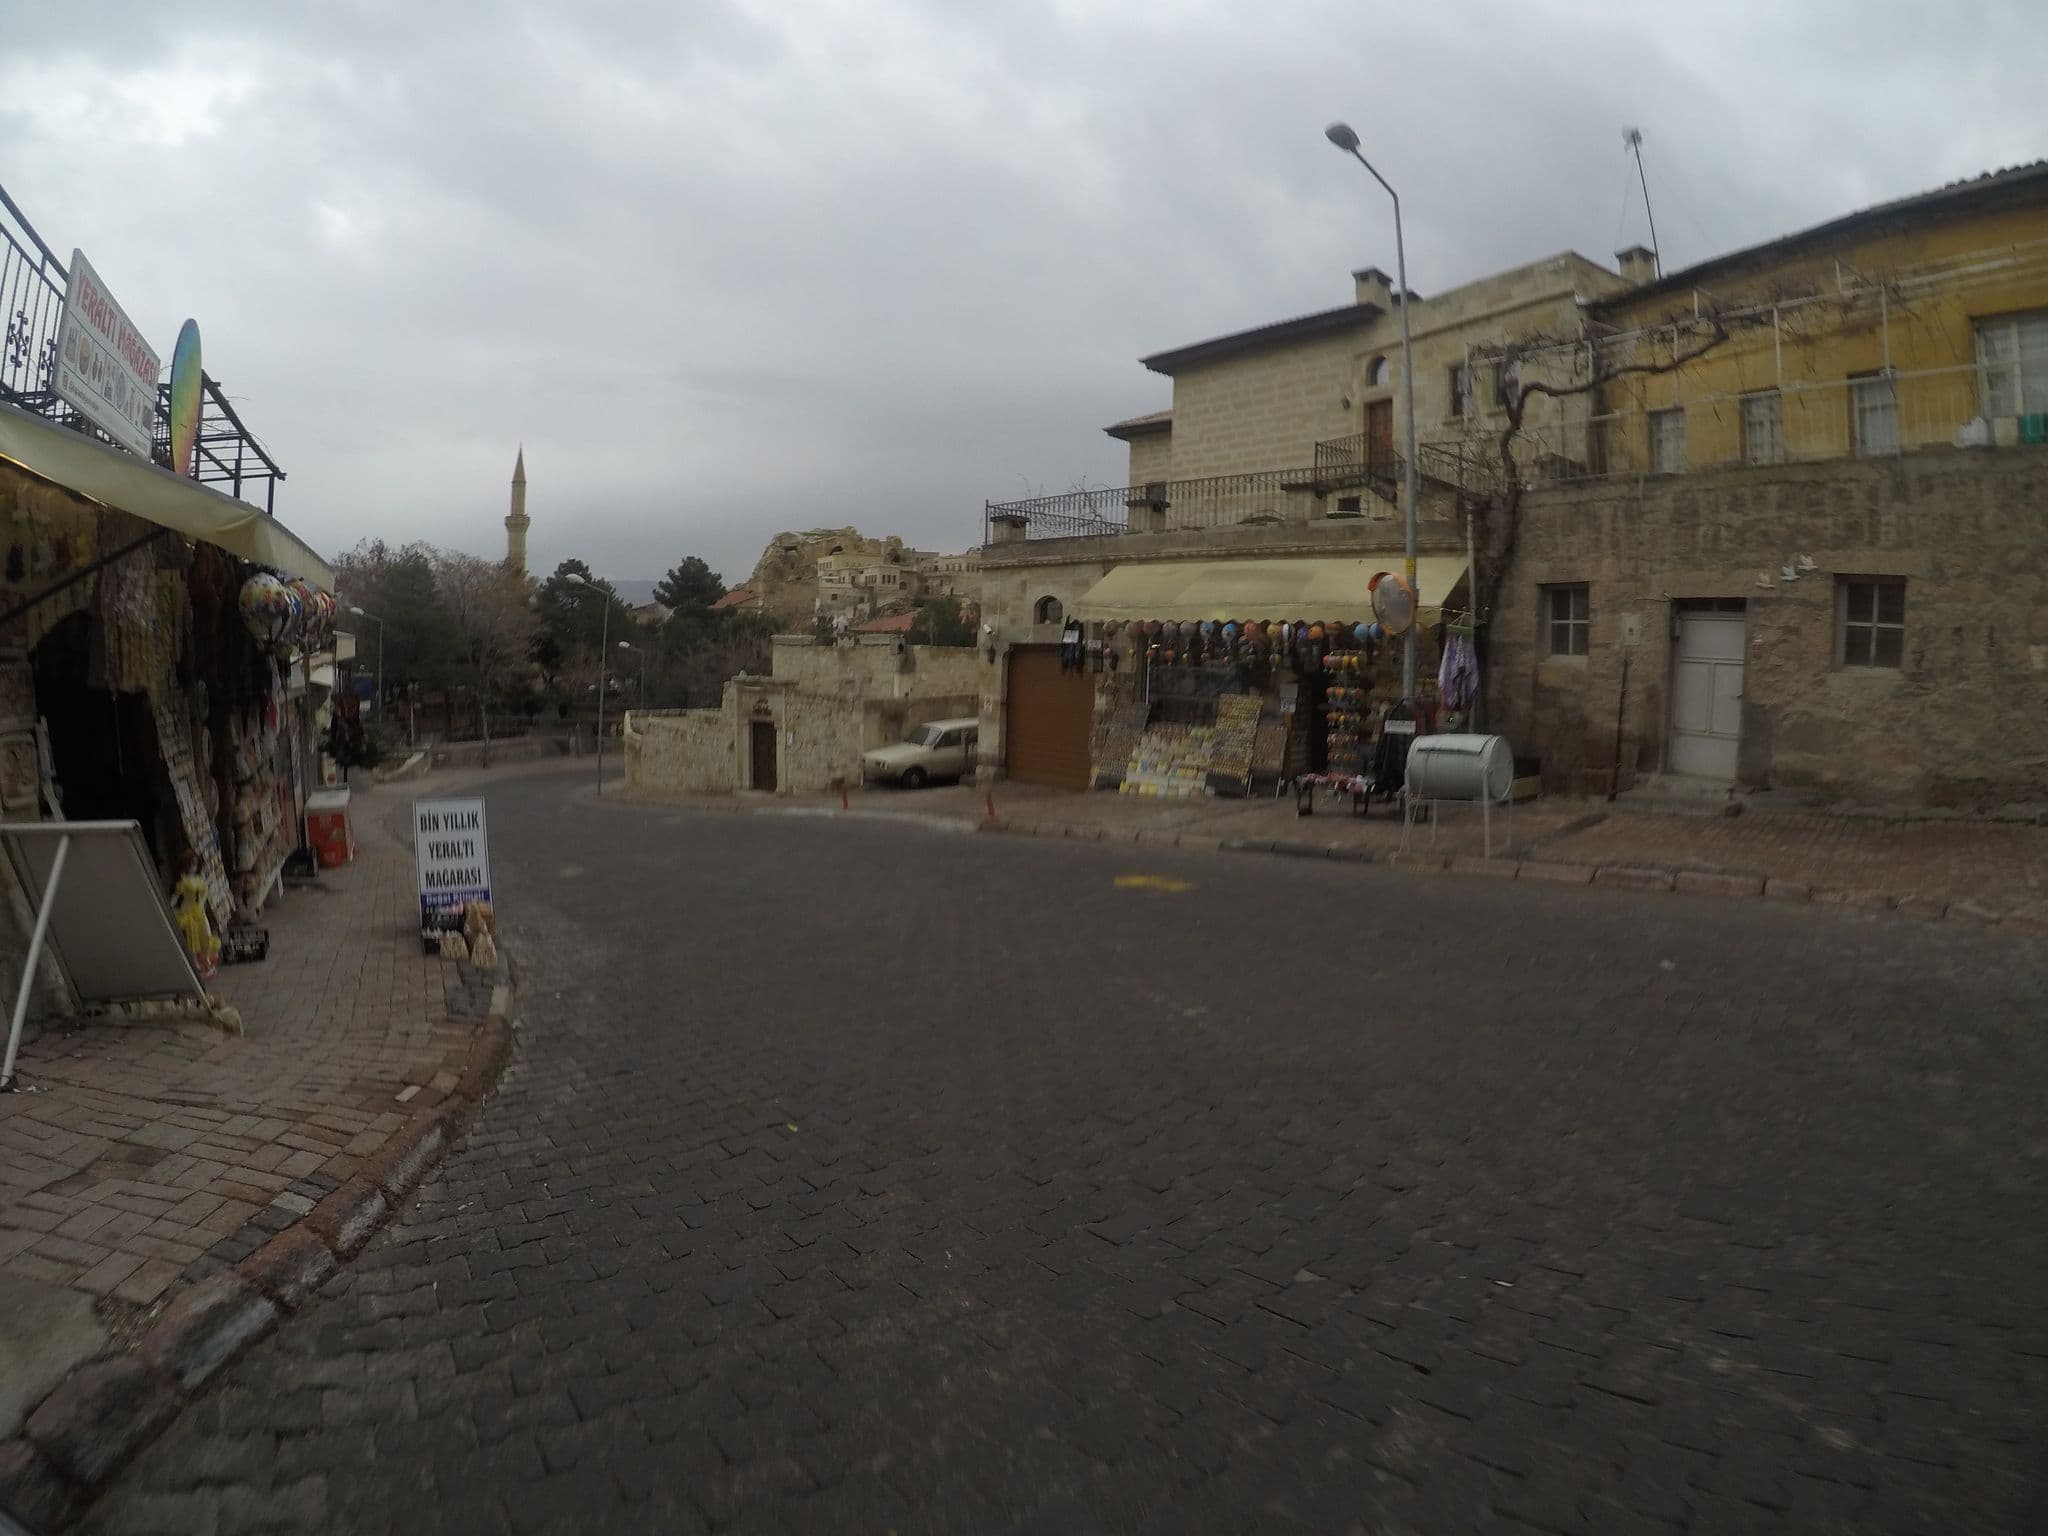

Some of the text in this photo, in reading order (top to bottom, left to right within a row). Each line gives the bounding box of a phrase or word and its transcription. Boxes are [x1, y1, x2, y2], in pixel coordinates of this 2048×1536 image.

[76, 269, 117, 343] YERALTI
[420, 809, 480, 832] BİN YILLIK
[428, 838, 474, 860] YERALTI
